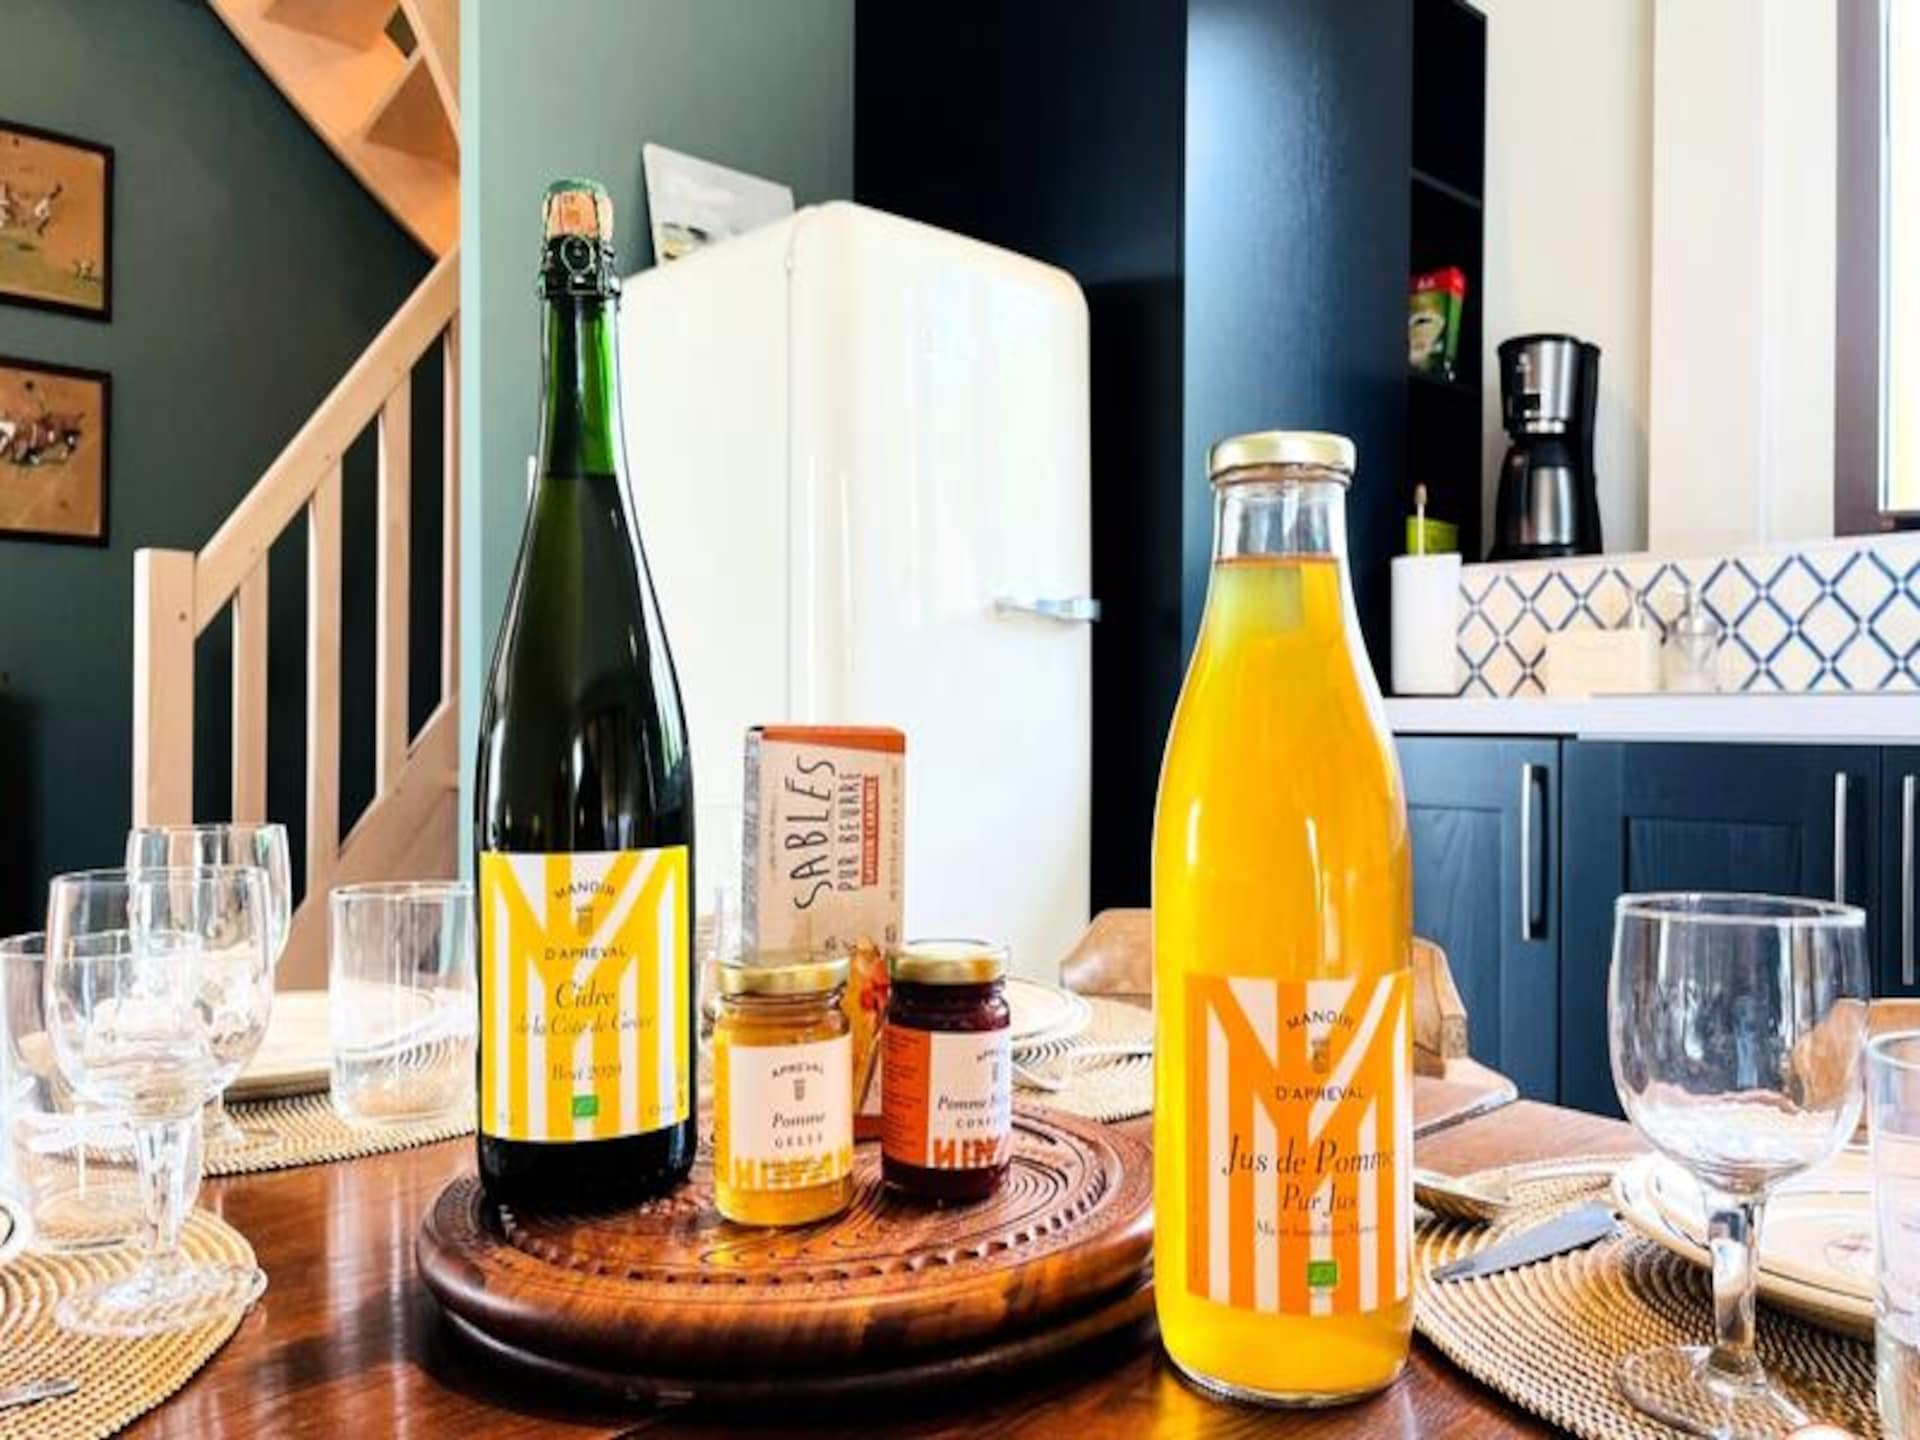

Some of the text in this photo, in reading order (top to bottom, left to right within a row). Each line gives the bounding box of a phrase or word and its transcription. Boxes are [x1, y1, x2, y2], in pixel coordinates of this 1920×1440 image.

[838, 772, 862, 891] PUR BEURRE
[555, 978, 617, 1010] Cidre
[1286, 1009, 1355, 1031] MANOIR
[772, 1111, 826, 1129] Pomme
[1221, 1135, 1269, 1176] Jus
[1276, 1136, 1307, 1174] de
[1283, 1182, 1357, 1217] Pur Jus
